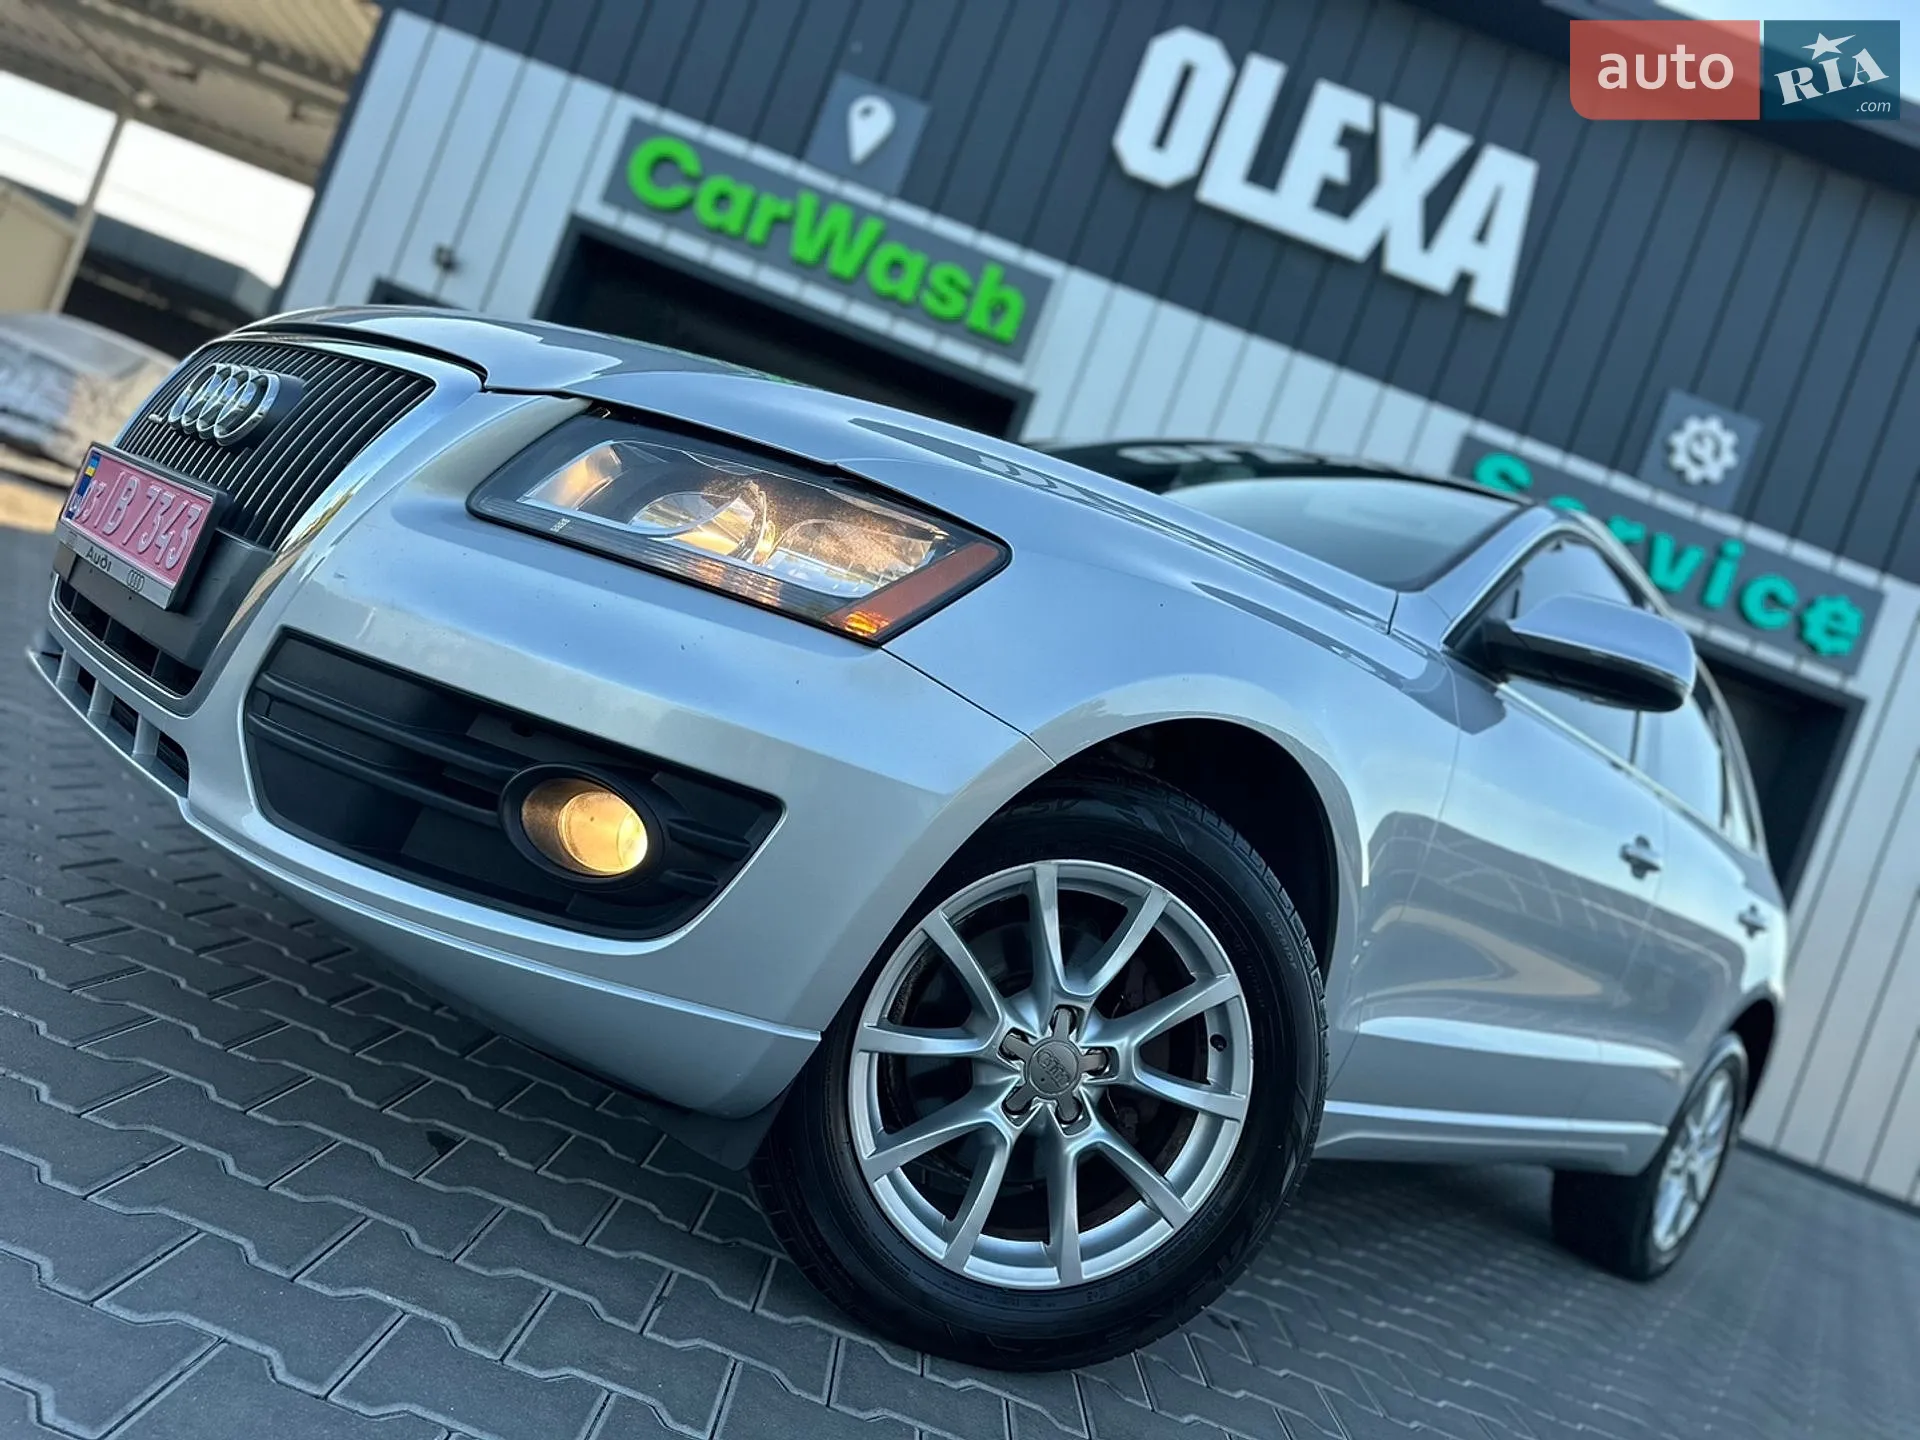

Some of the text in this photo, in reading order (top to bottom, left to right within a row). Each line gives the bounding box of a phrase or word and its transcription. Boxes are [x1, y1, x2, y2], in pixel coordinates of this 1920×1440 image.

[626, 136, 1026, 344] CarWash
[1112, 24, 1539, 317] OLEXA
[121, 484, 204, 571] 7343
[1473, 451, 1865, 657] Srvice
